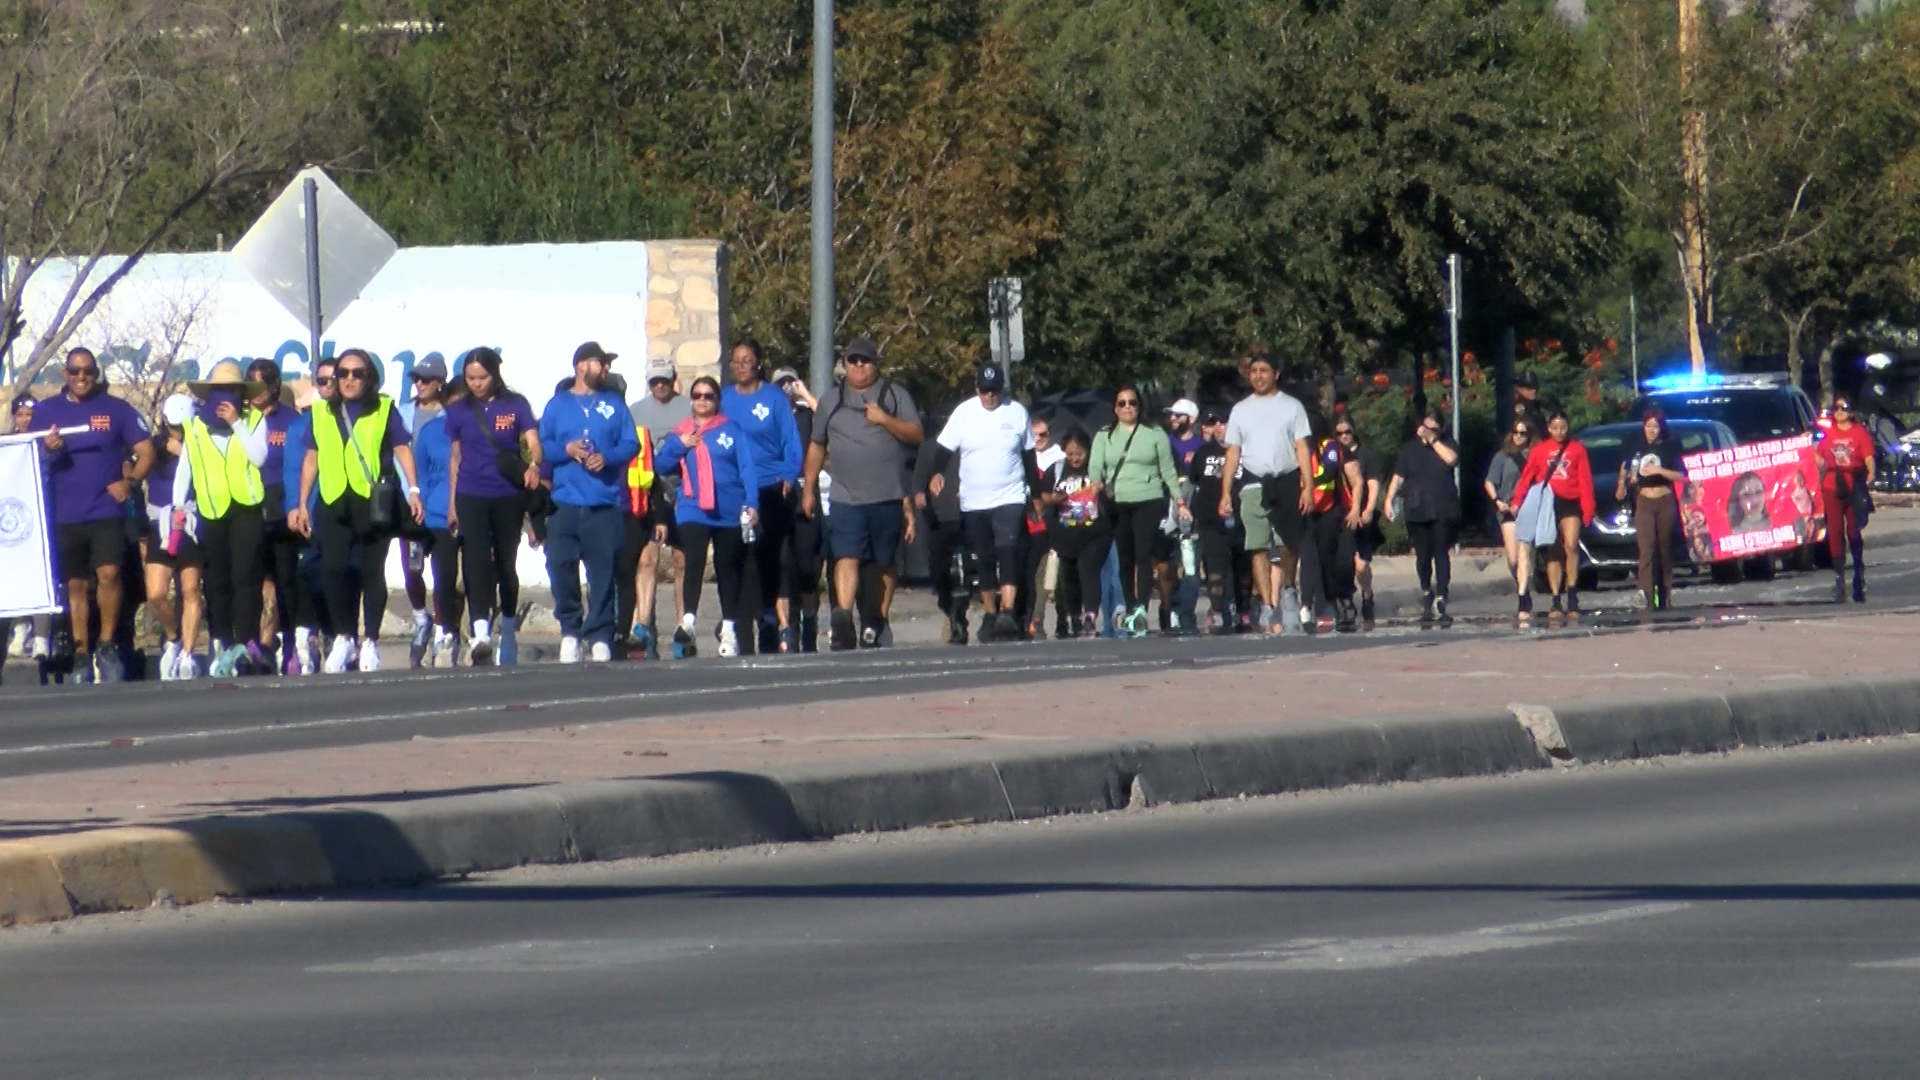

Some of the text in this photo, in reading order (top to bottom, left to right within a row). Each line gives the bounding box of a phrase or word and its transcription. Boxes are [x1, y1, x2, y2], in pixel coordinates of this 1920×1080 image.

[1686, 396, 1731, 404] POLICE
[1702, 452, 1724, 467] WALK
[1723, 449, 1734, 462] TO
[1734, 446, 1752, 460] TAKE
[1758, 441, 1783, 456] STAND
[1783, 434, 1813, 450] AGAINST
[1716, 463, 1734, 477] AND
[1734, 456, 1772, 473] SENSELESS
